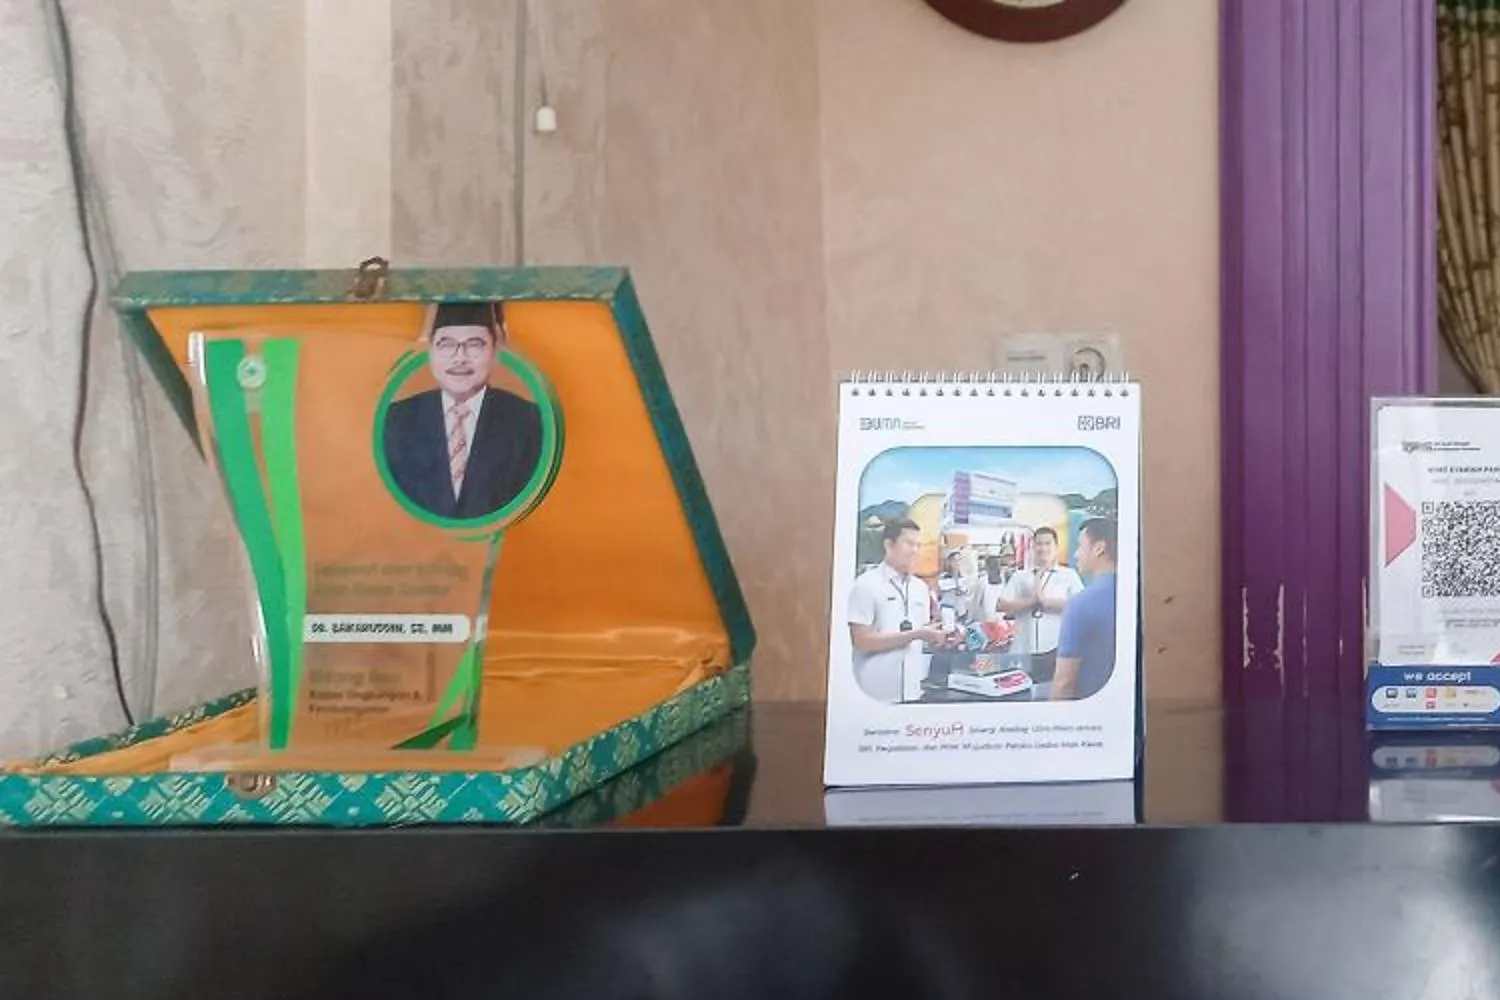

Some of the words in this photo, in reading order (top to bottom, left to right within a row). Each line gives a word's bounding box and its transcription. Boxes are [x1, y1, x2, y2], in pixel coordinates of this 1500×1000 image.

[1095, 415, 1121, 431] BRI
[1403, 672, 1423, 682] we
[1427, 671, 1471, 684] accept
